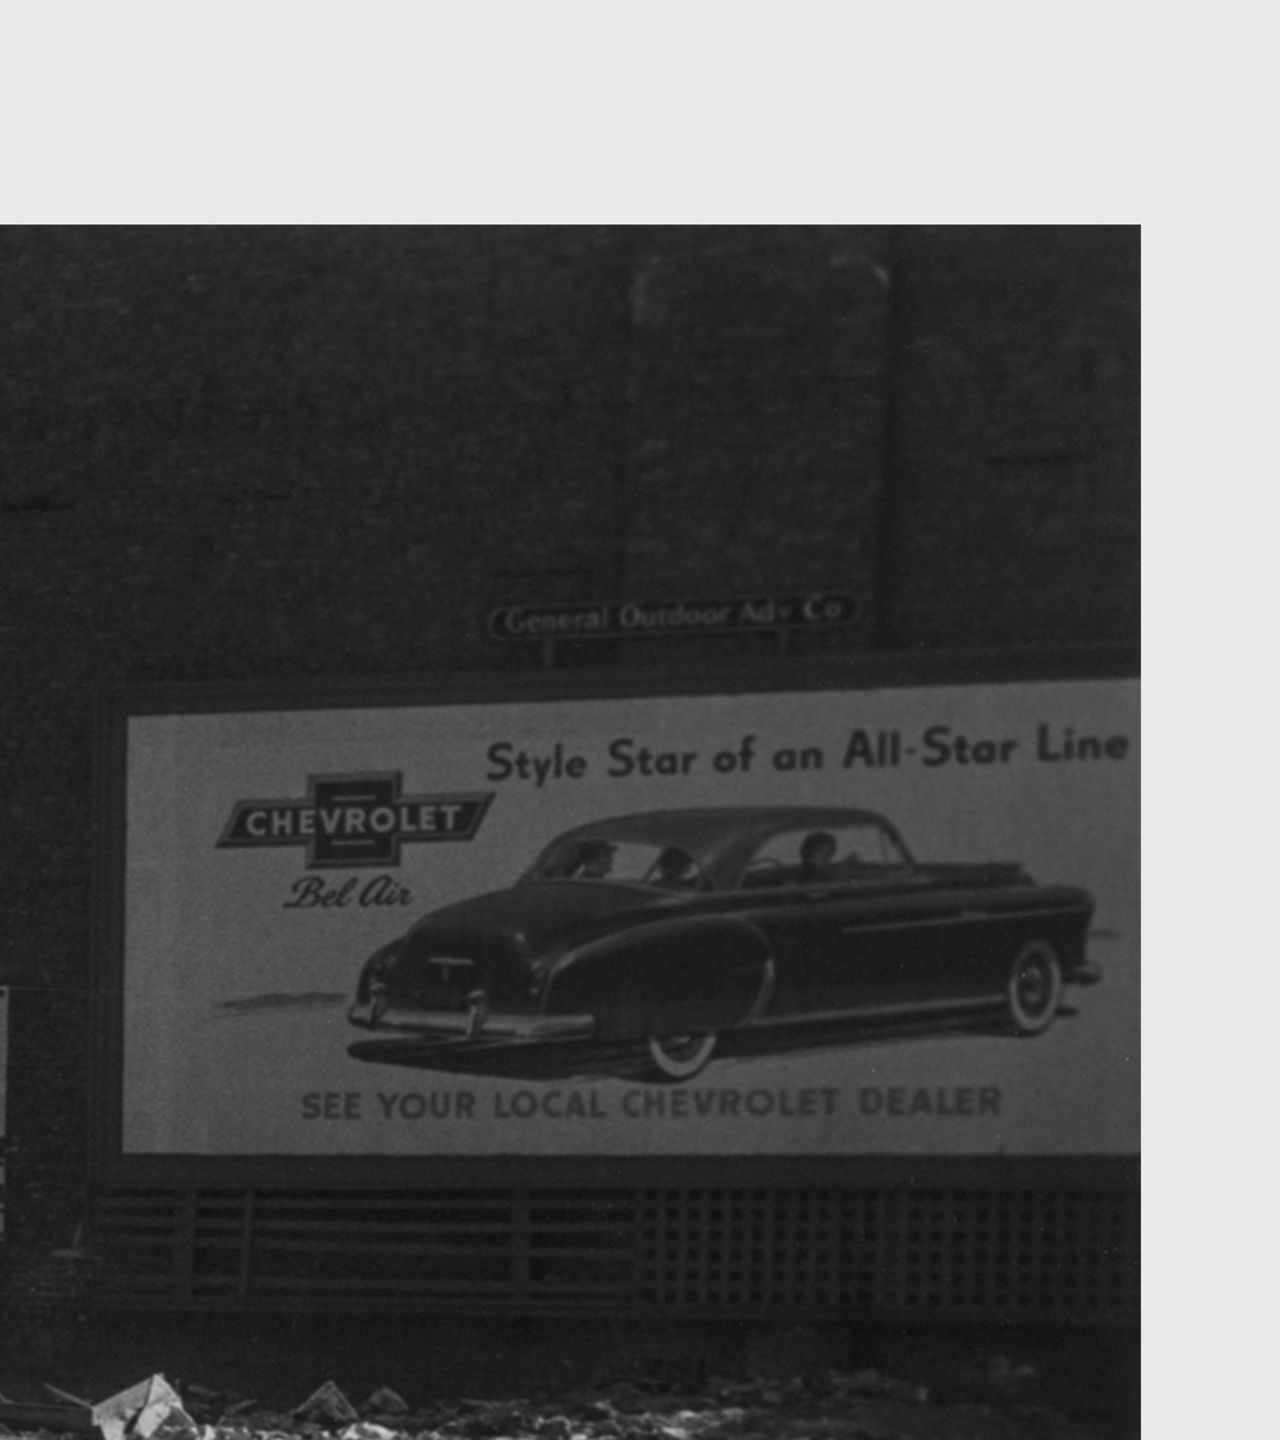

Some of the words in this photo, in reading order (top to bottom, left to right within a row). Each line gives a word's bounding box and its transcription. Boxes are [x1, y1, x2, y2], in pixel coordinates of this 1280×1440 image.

[504, 606, 609, 633] General
[618, 602, 731, 628] Outdoor
[485, 741, 588, 788] Style
[607, 737, 698, 778] Star
[712, 735, 757, 774] of
[771, 748, 824, 772] an
[842, 725, 1018, 768] All-Star
[1035, 722, 1130, 763] Line
[244, 804, 463, 838] CHEVROLET
[282, 875, 358, 910] Bel
[358, 873, 414, 908] Air
[300, 1091, 362, 1120] SEE
[376, 1090, 476, 1121] YOUR
[493, 1088, 608, 1120] LOCAL
[621, 1087, 840, 1120] CHEVROLET
[859, 1086, 1003, 1117] DEALER
